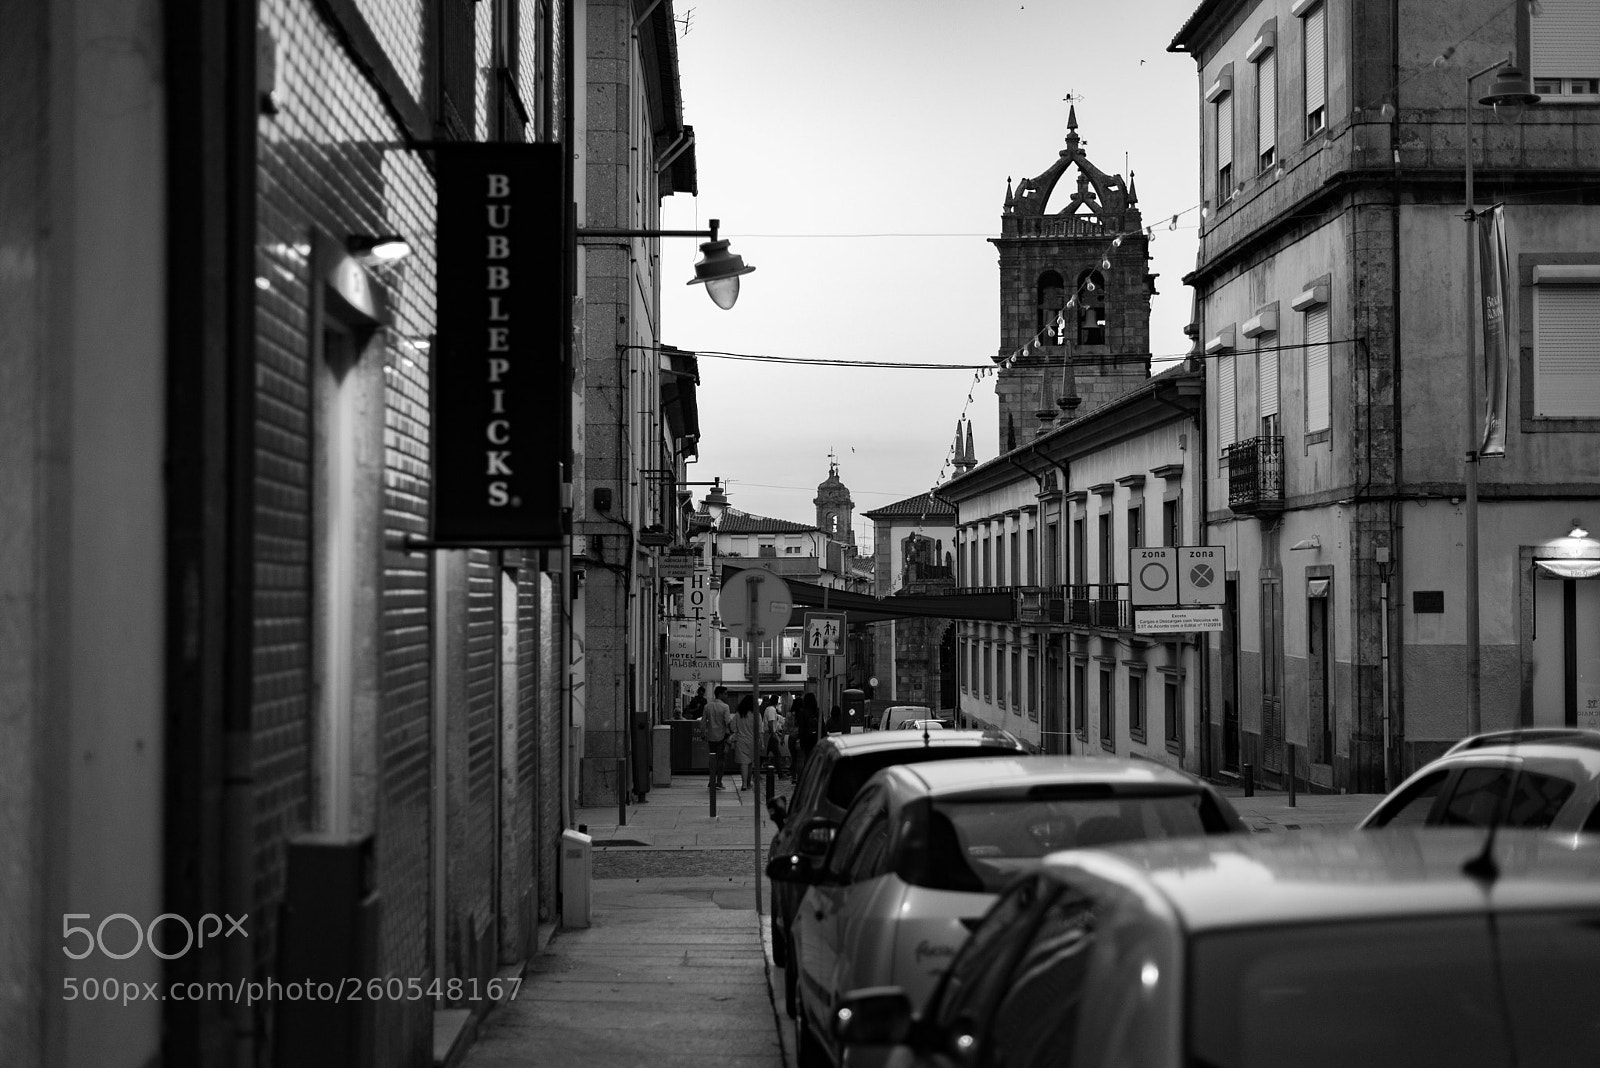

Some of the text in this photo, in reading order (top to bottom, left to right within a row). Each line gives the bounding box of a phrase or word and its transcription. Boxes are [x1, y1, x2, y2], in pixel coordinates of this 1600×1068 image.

[1142, 550, 1166, 558] zona
[1189, 550, 1214, 558] zona
[690, 574, 704, 654] HOT
